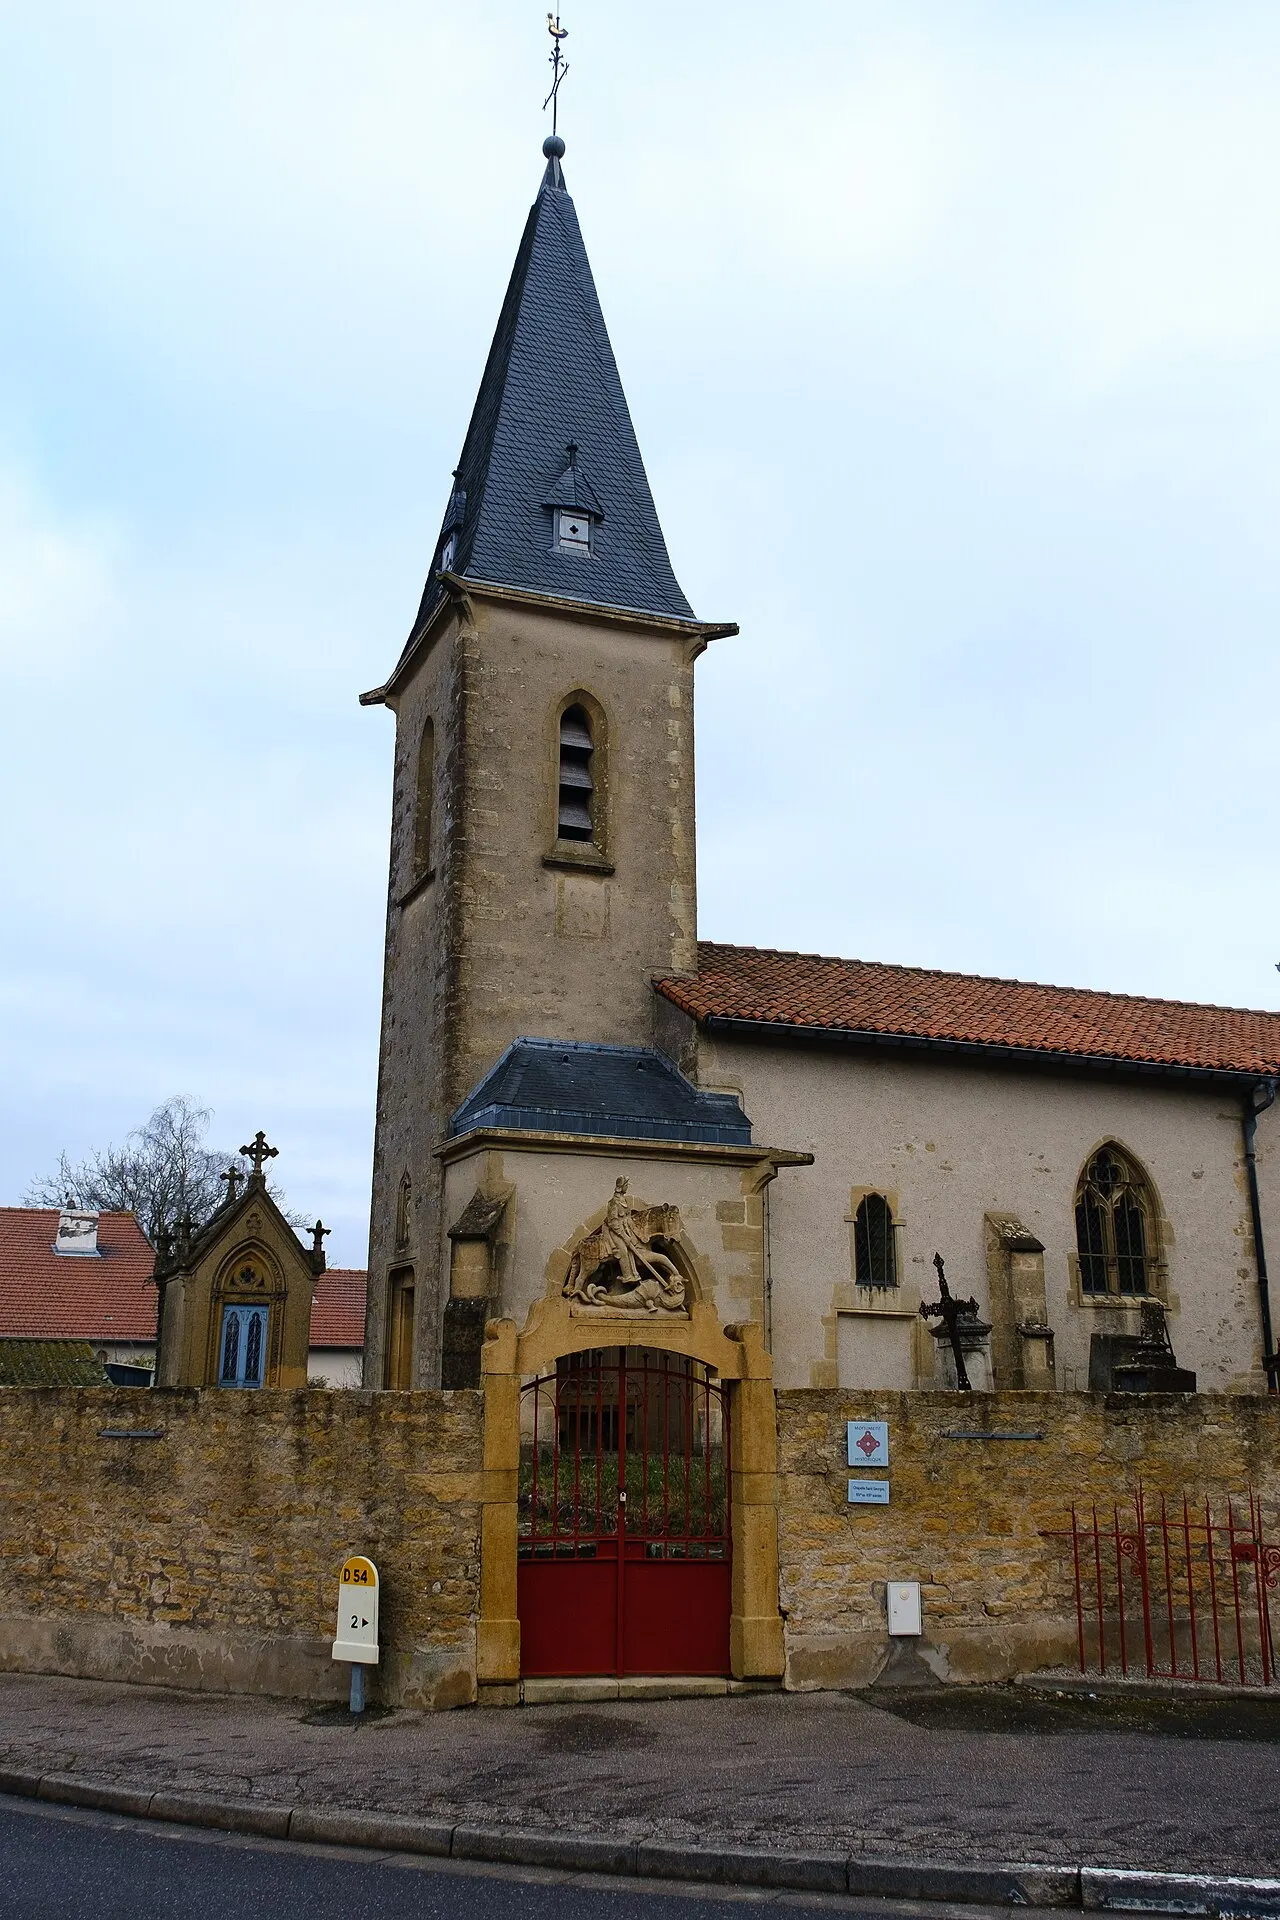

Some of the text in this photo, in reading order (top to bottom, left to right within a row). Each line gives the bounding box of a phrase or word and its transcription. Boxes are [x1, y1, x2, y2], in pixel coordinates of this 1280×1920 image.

[344, 1569, 368, 1583] D 54
[351, 1615, 358, 1628] 2
